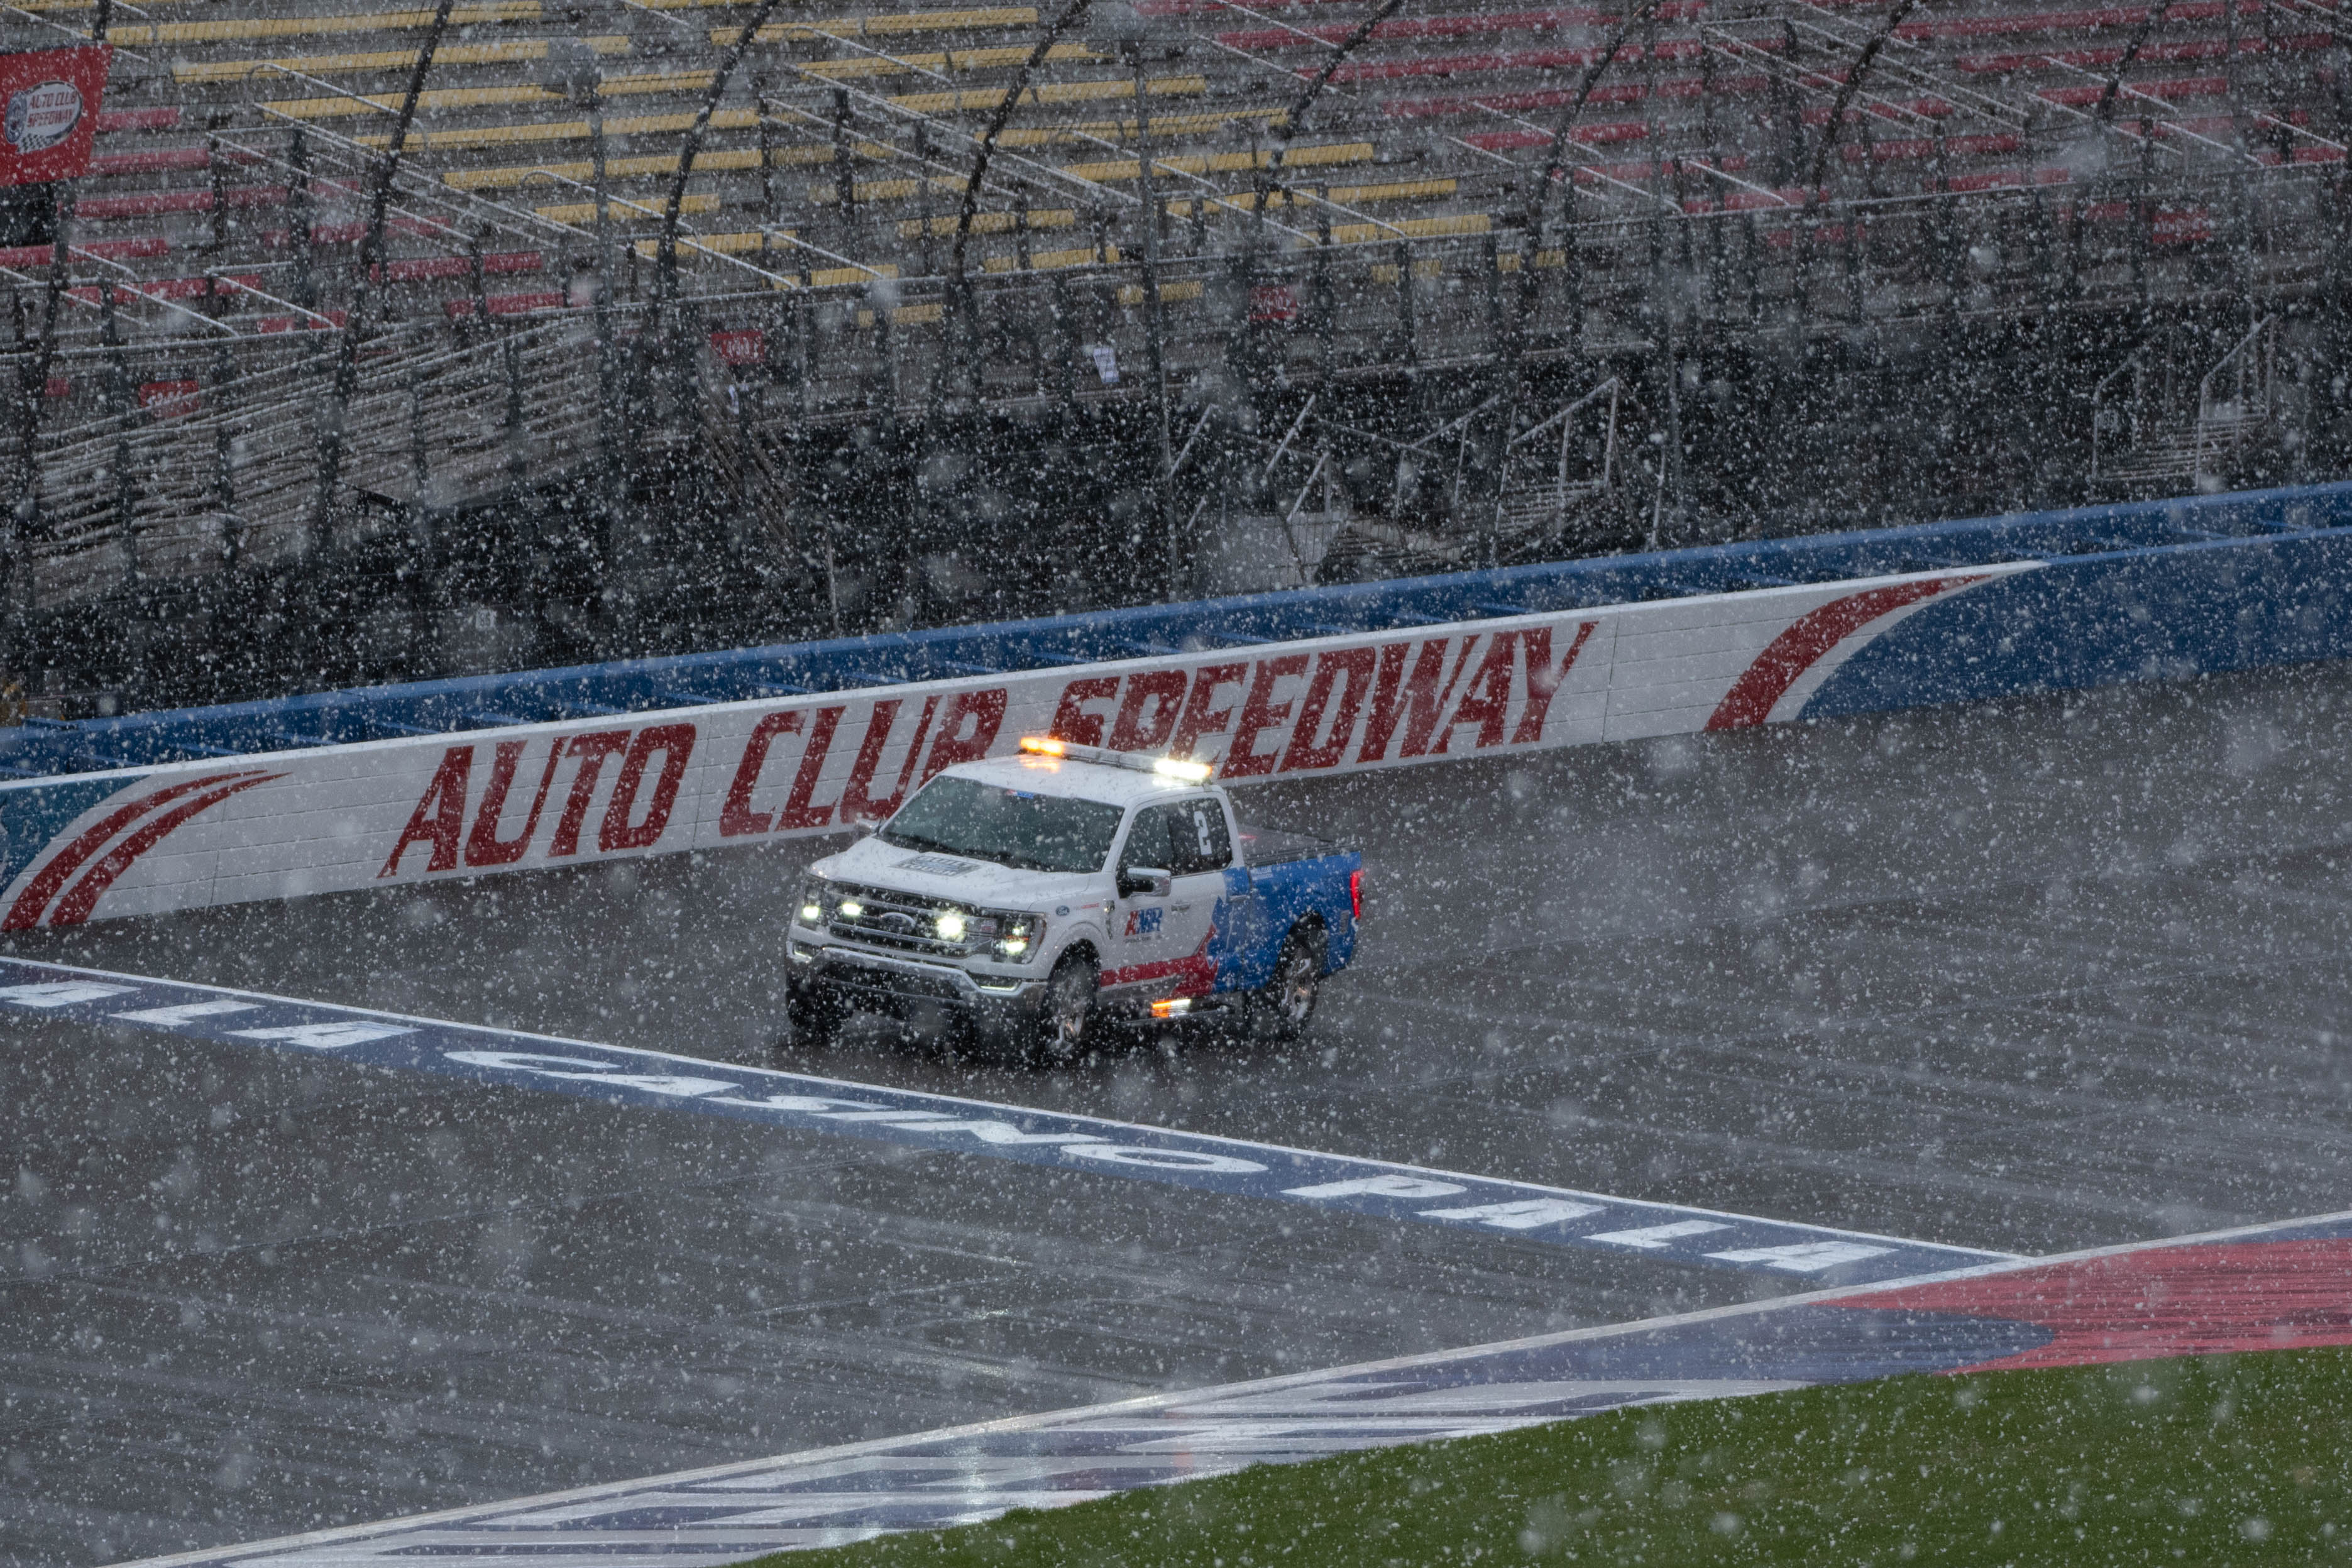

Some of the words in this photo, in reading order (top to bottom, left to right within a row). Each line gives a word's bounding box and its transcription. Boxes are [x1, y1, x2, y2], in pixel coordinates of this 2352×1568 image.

[28, 109, 73, 127] SPEEDWAY
[29, 93, 54, 109] AUTO
[55, 91, 76, 107] CLUB
[376, 723, 696, 879] AUTO
[718, 688, 1008, 836] CLUB
[1047, 620, 1598, 780] SPEEDWAY
[1194, 811, 1212, 855] 2
[1124, 907, 1162, 936] AMR
[0, 978, 421, 1048] ALA
[442, 1051, 1269, 1173] CASINO
[1280, 1173, 1898, 1273] PALA
